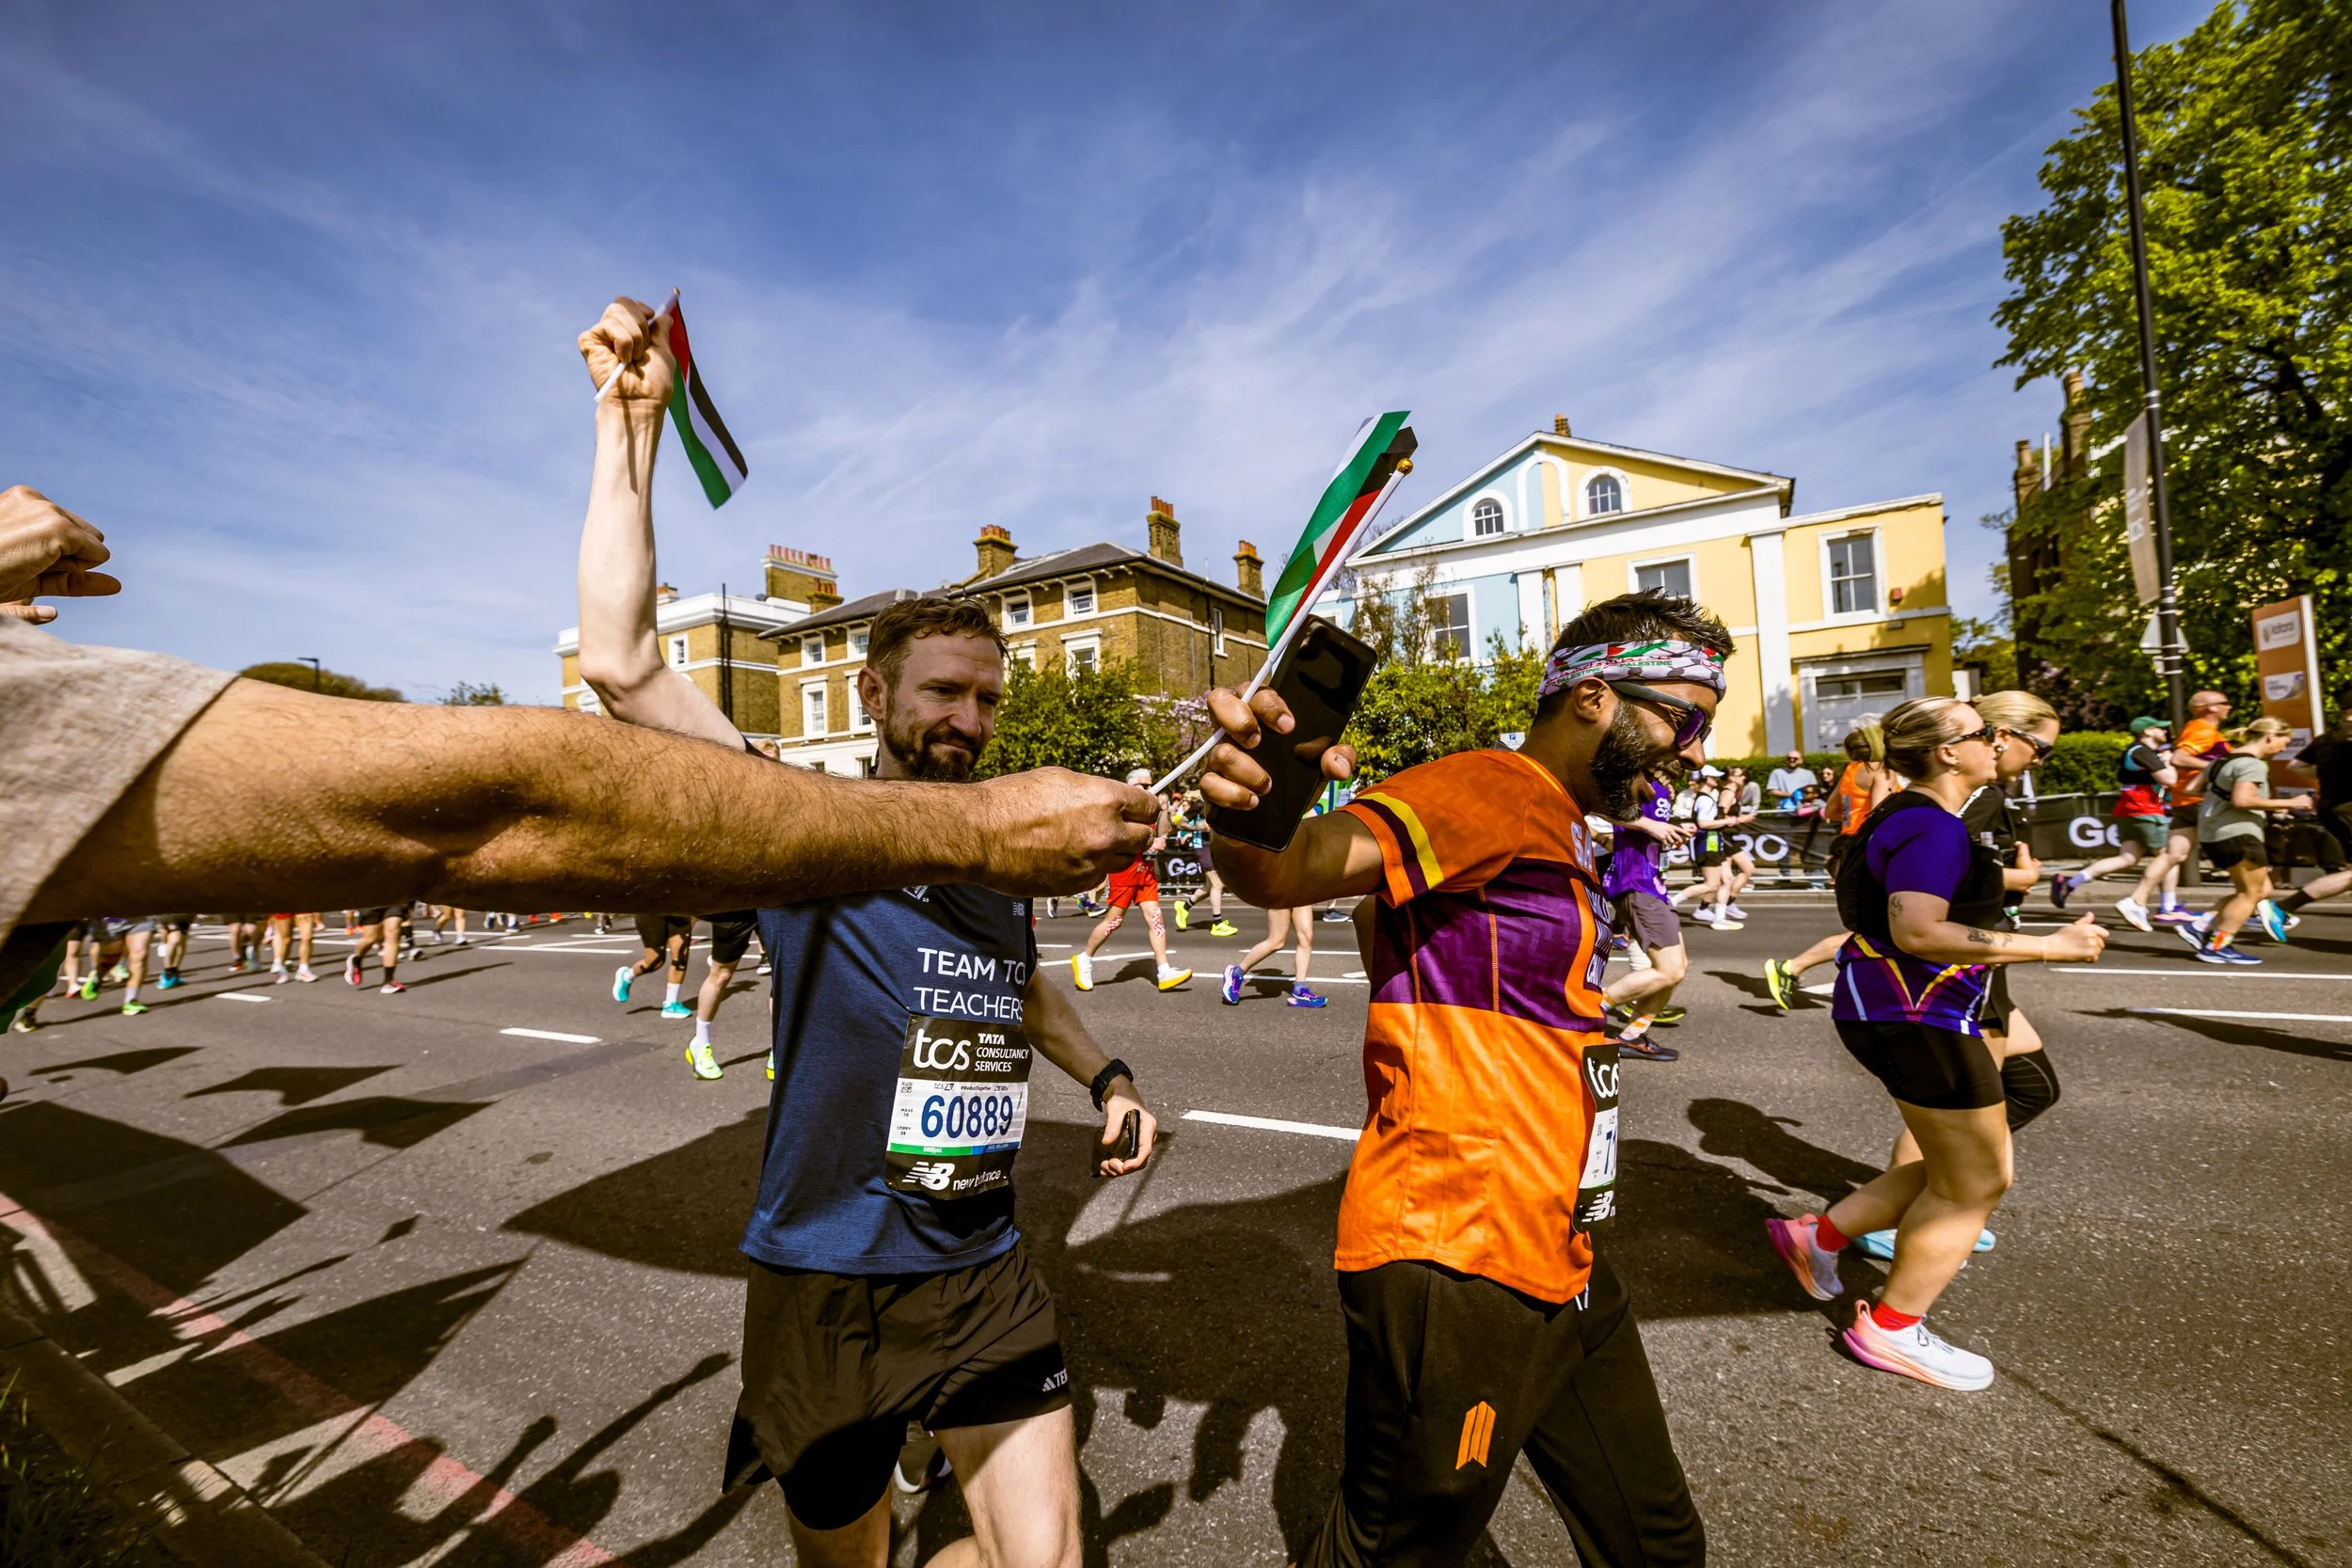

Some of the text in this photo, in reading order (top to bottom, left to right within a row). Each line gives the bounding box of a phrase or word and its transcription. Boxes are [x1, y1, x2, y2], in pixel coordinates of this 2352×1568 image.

[1620, 659, 1673, 668] PALESTINE
[1557, 666, 1601, 685] PALESTINE
[916, 947, 996, 982] TEAM
[913, 986, 1025, 1023] TEACHERS
[913, 1028, 971, 1070] tcs
[977, 1033, 1005, 1045] TATA
[976, 1046, 1030, 1059] CONSULTANCY
[974, 1061, 1012, 1072] SERVICES
[921, 1094, 1013, 1139] 60889
[952, 1169, 1001, 1191] new balance
